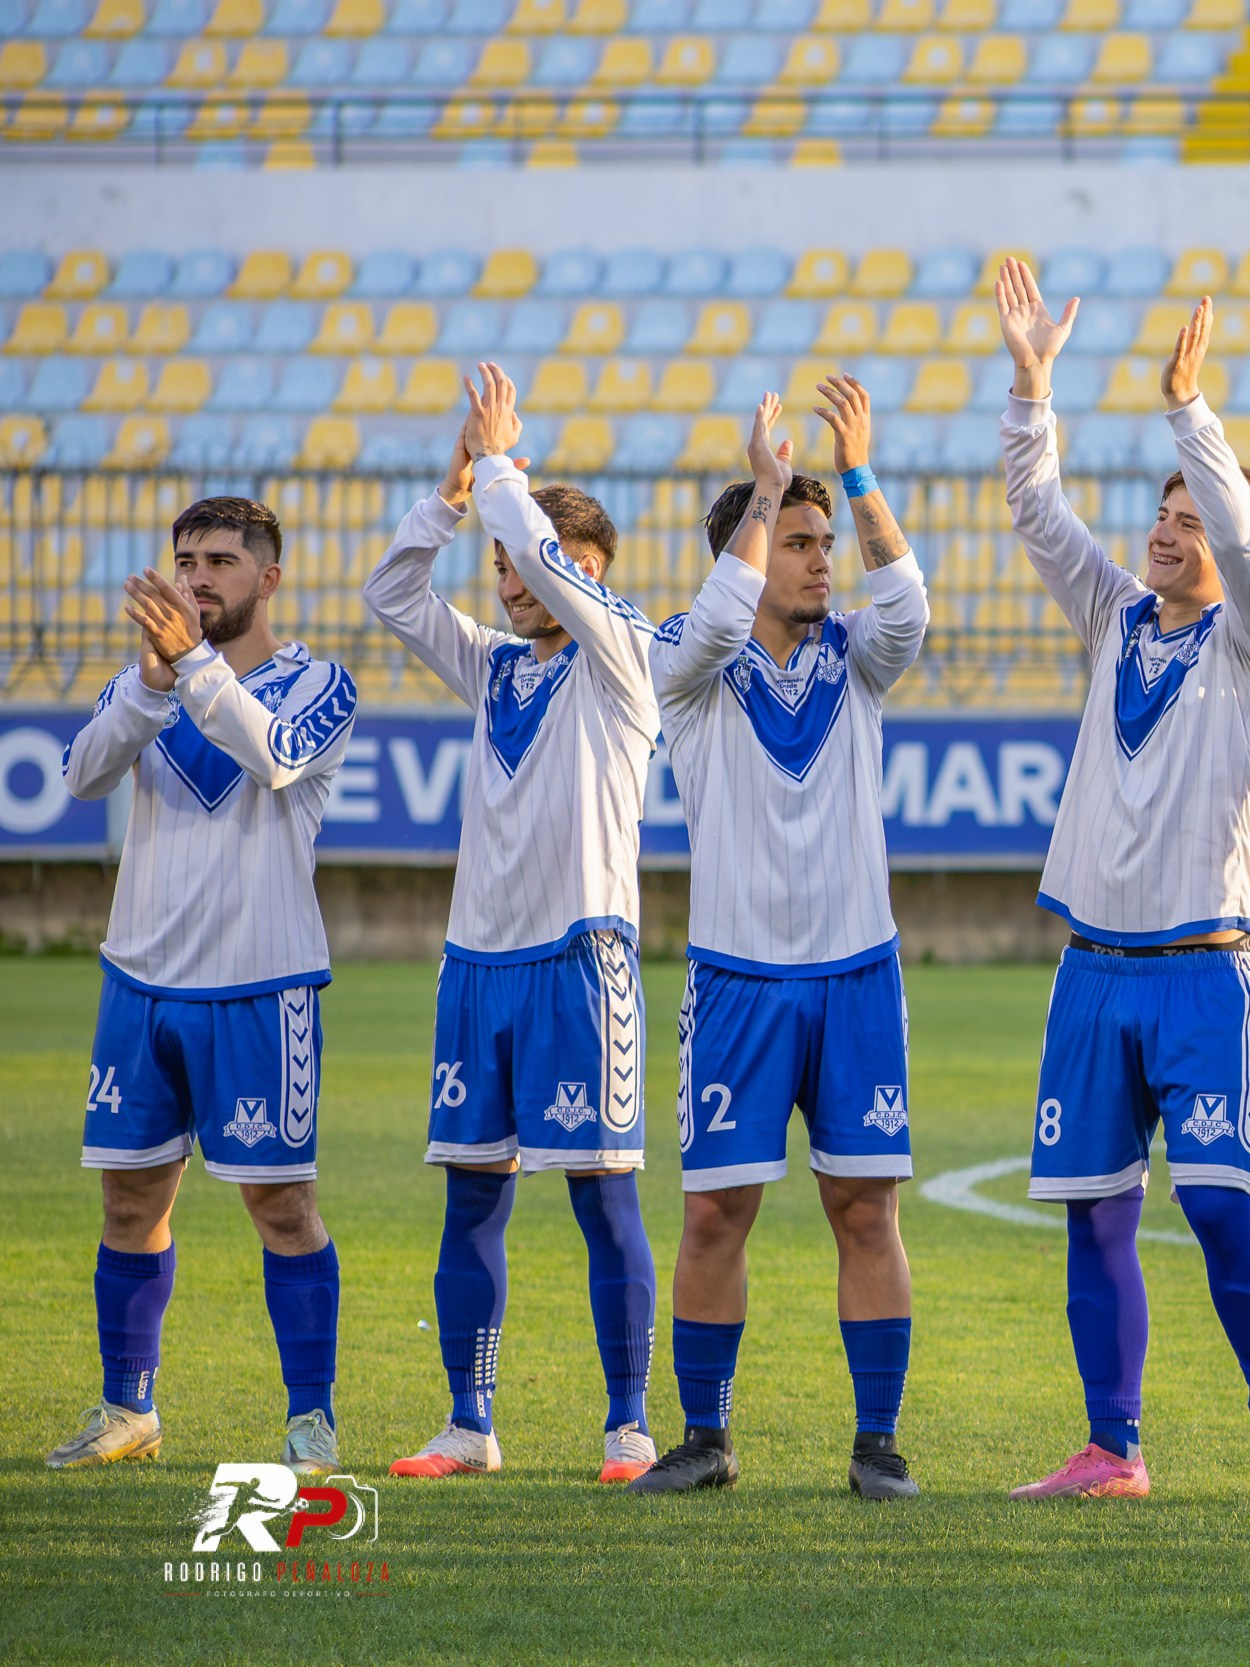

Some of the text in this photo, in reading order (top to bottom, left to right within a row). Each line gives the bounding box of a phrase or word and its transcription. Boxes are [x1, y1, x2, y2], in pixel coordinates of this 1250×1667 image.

[882, 740, 1064, 828] MAR
[86, 1063, 122, 1114] 24
[562, 1114, 580, 1126] 1912
[701, 1083, 736, 1132] 2
[1039, 1098, 1062, 1146] 8
[241, 1130, 258, 1141] 1912
[881, 1118, 899, 1130] 1912
[1197, 1128, 1216, 1138] 1912
